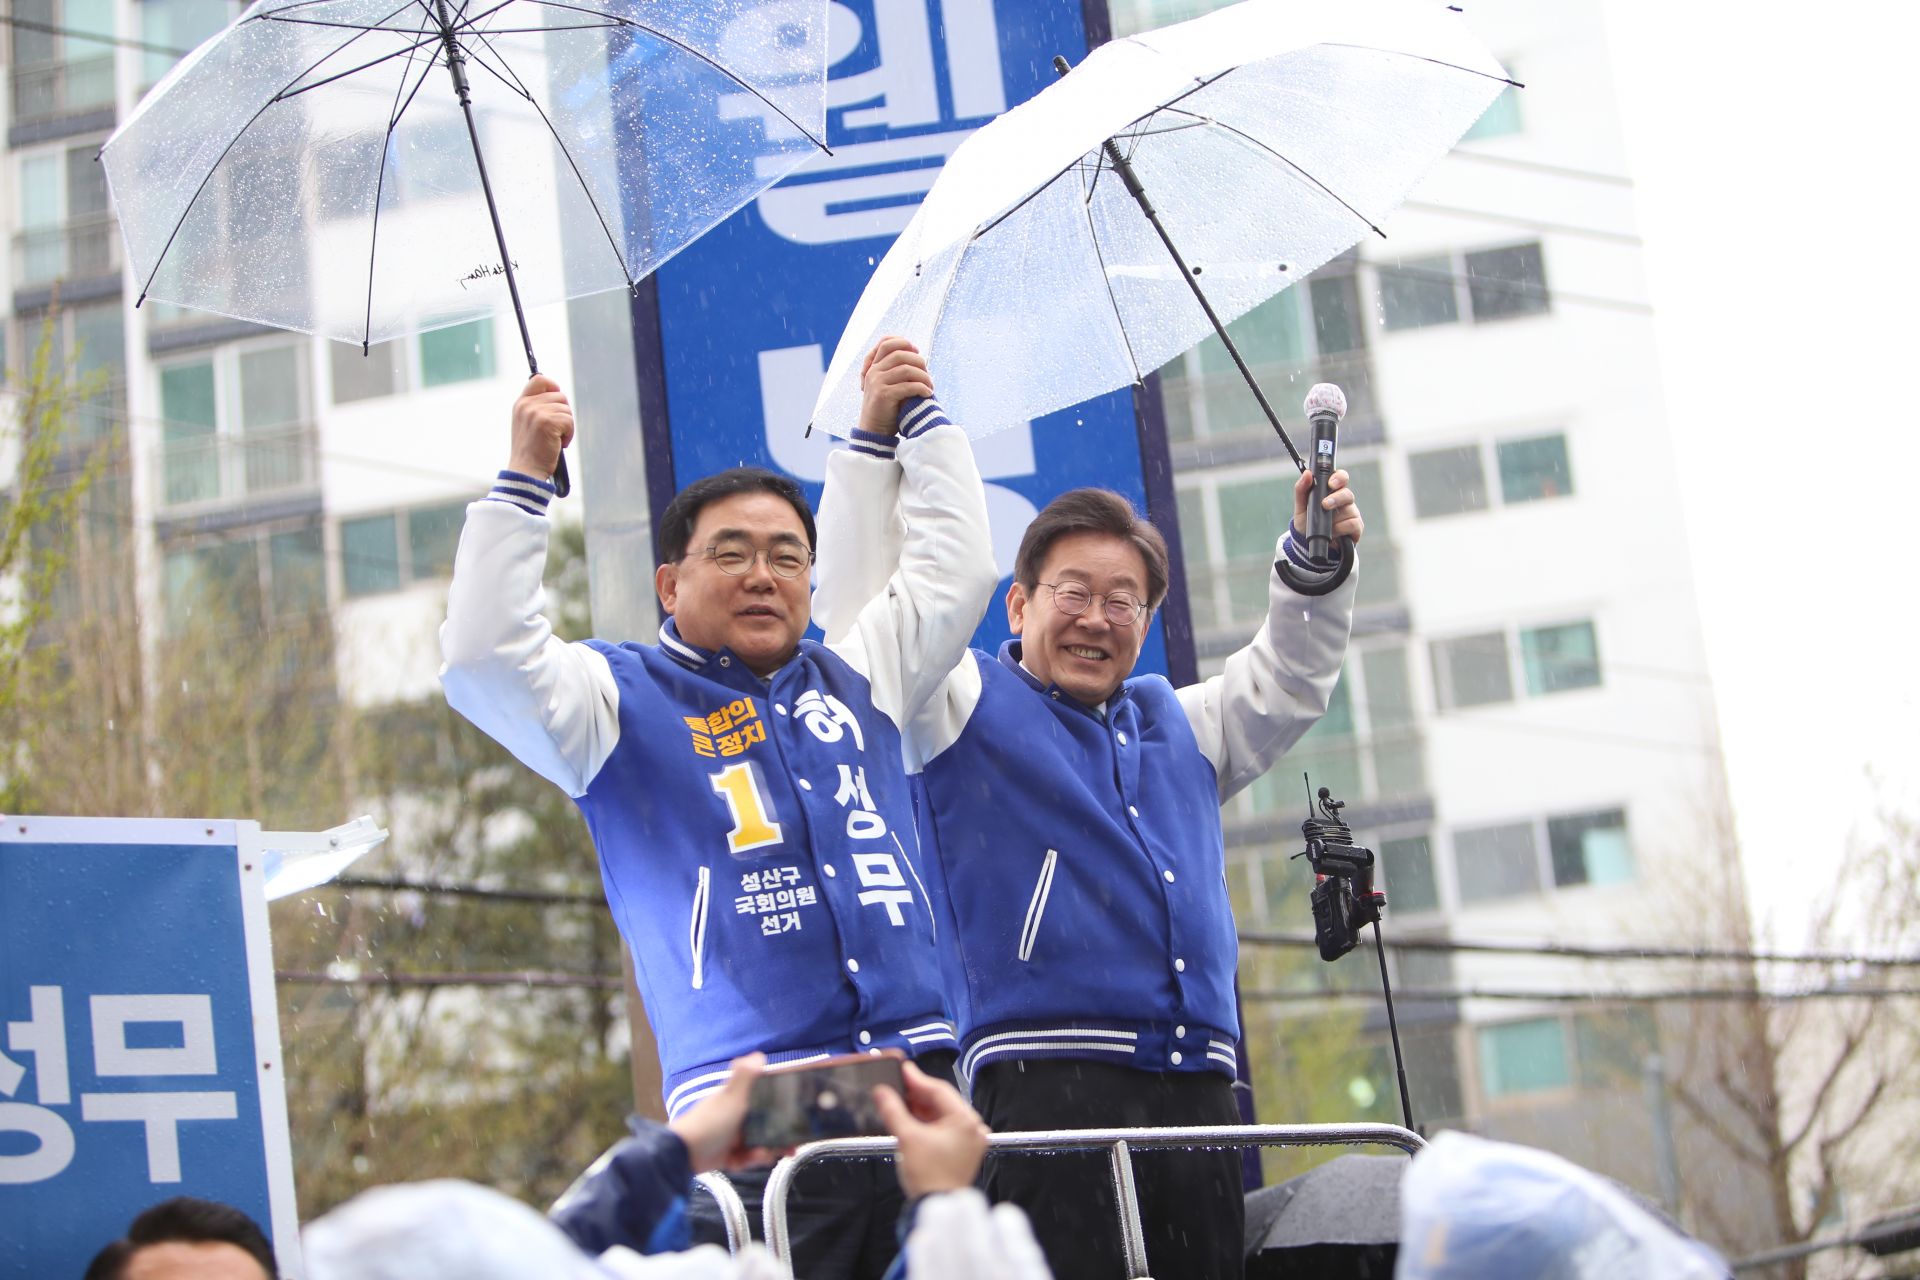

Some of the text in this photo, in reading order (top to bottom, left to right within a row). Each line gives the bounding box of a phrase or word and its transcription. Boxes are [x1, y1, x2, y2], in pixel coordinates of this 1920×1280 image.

[683, 697, 758, 735] 통합의
[691, 719, 767, 758] 큰 정치
[710, 761, 784, 854] 1
[792, 689, 914, 927] 허성무
[740, 866, 802, 893] 성산구
[734, 885, 818, 915] 국회의원
[760, 911, 802, 936] 선거
